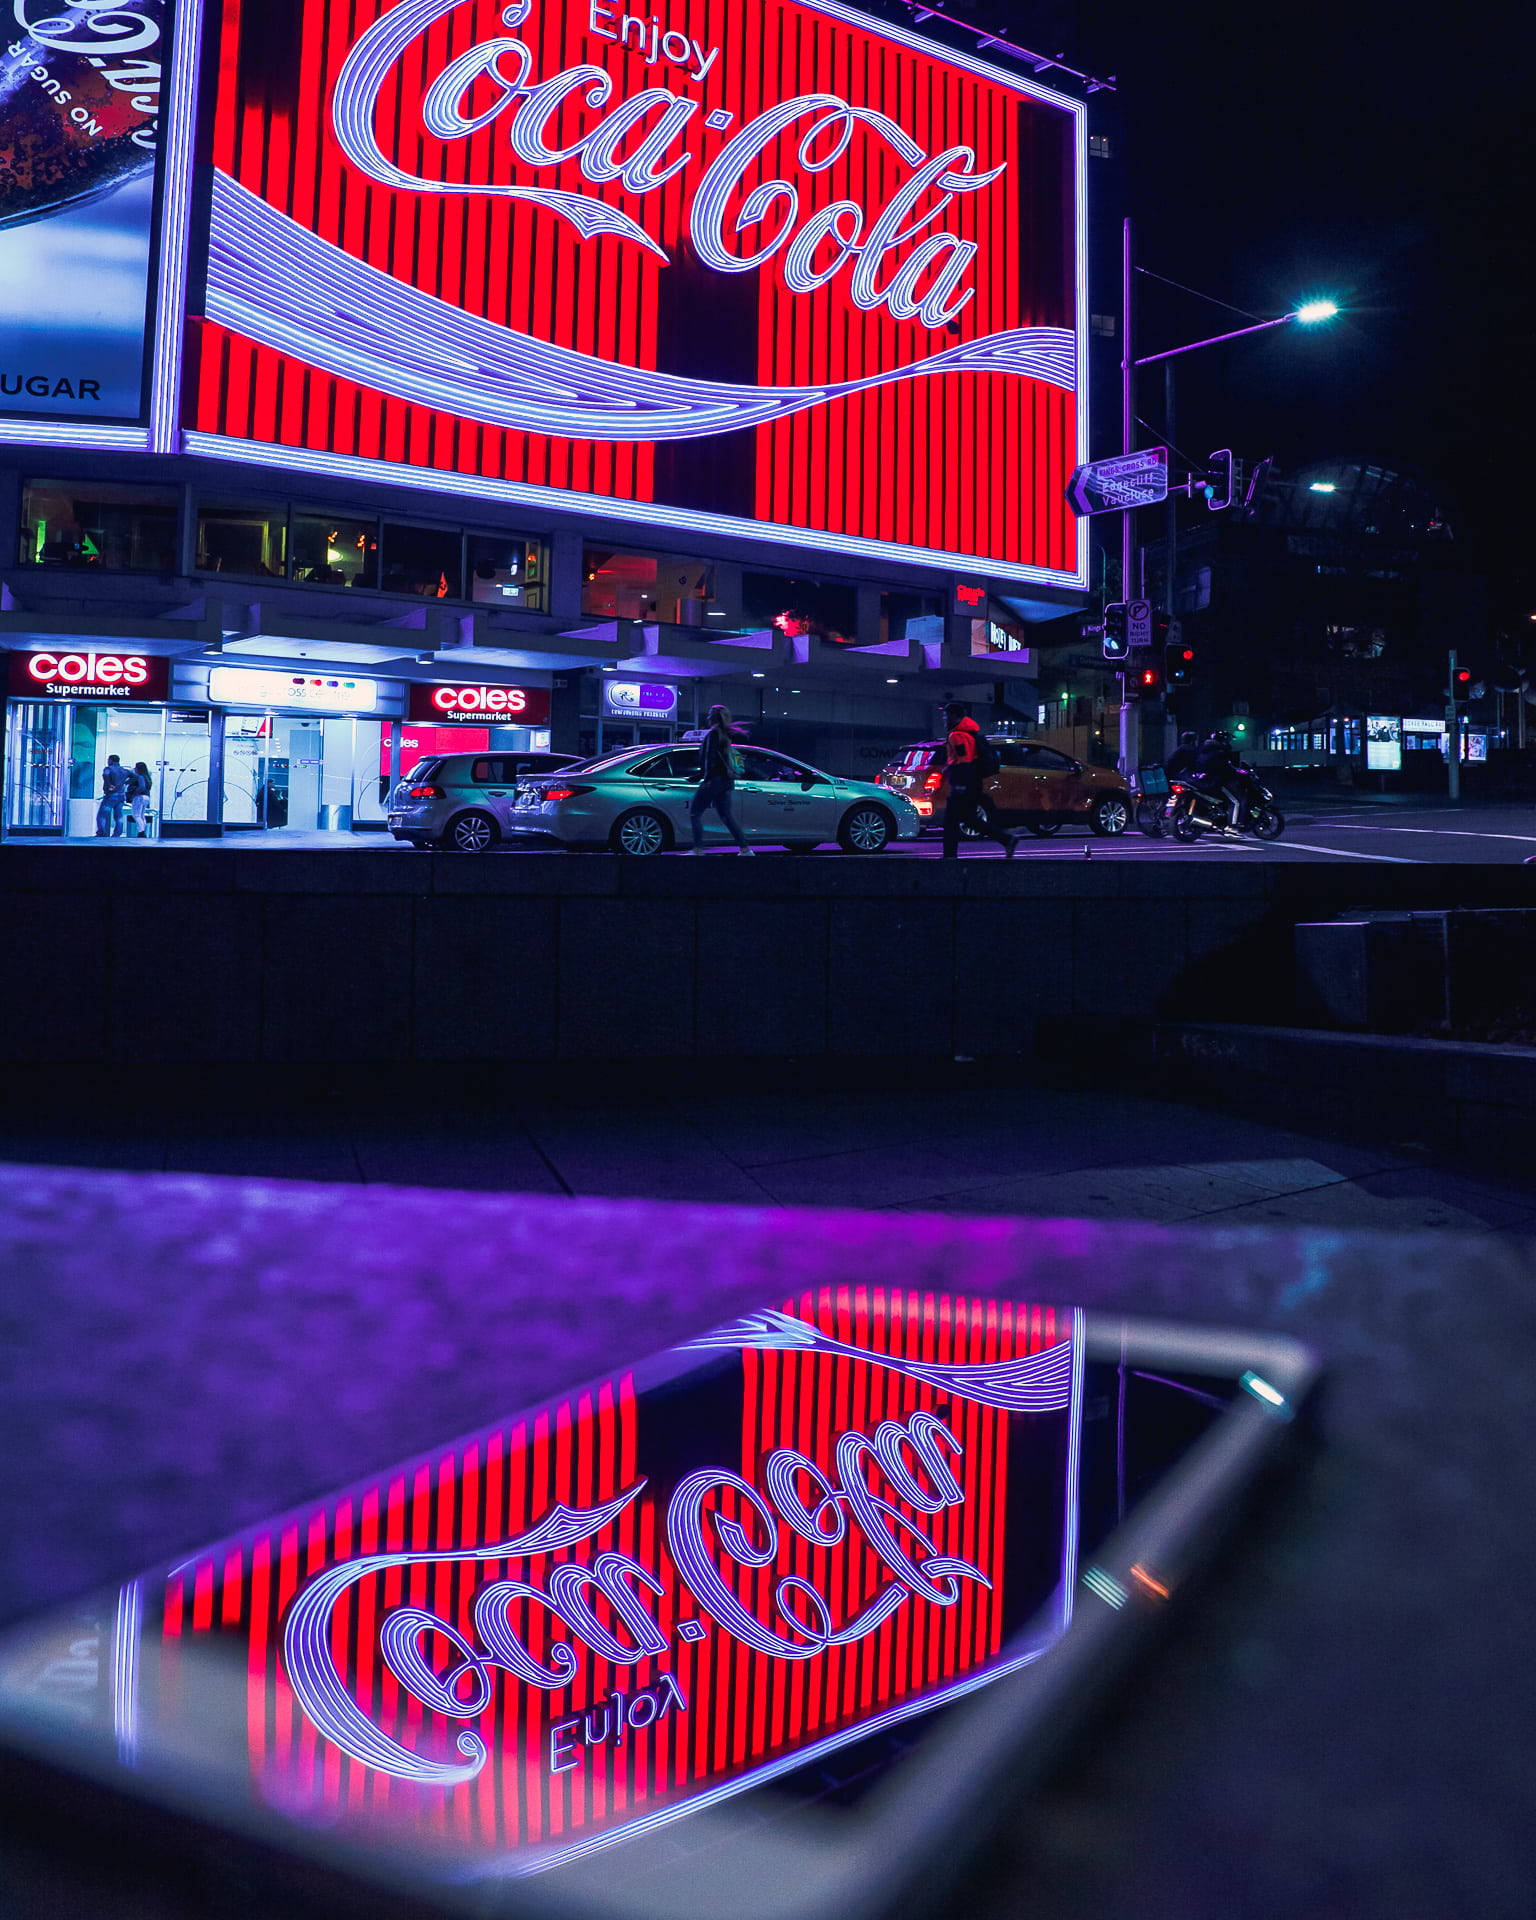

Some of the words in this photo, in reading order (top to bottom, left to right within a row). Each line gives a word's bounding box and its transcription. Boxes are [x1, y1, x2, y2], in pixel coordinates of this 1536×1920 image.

[588, 0, 720, 82] Enjoy
[8, 40, 72, 105] SUGAR
[71, 107, 104, 137] NO
[1132, 622, 1146, 630] NO
[28, 653, 148, 683] coles
[45, 682, 131, 696] Supermarket
[434, 686, 527, 711] coles
[446, 711, 512, 721] Supermarket
[383, 738, 419, 748] cles
